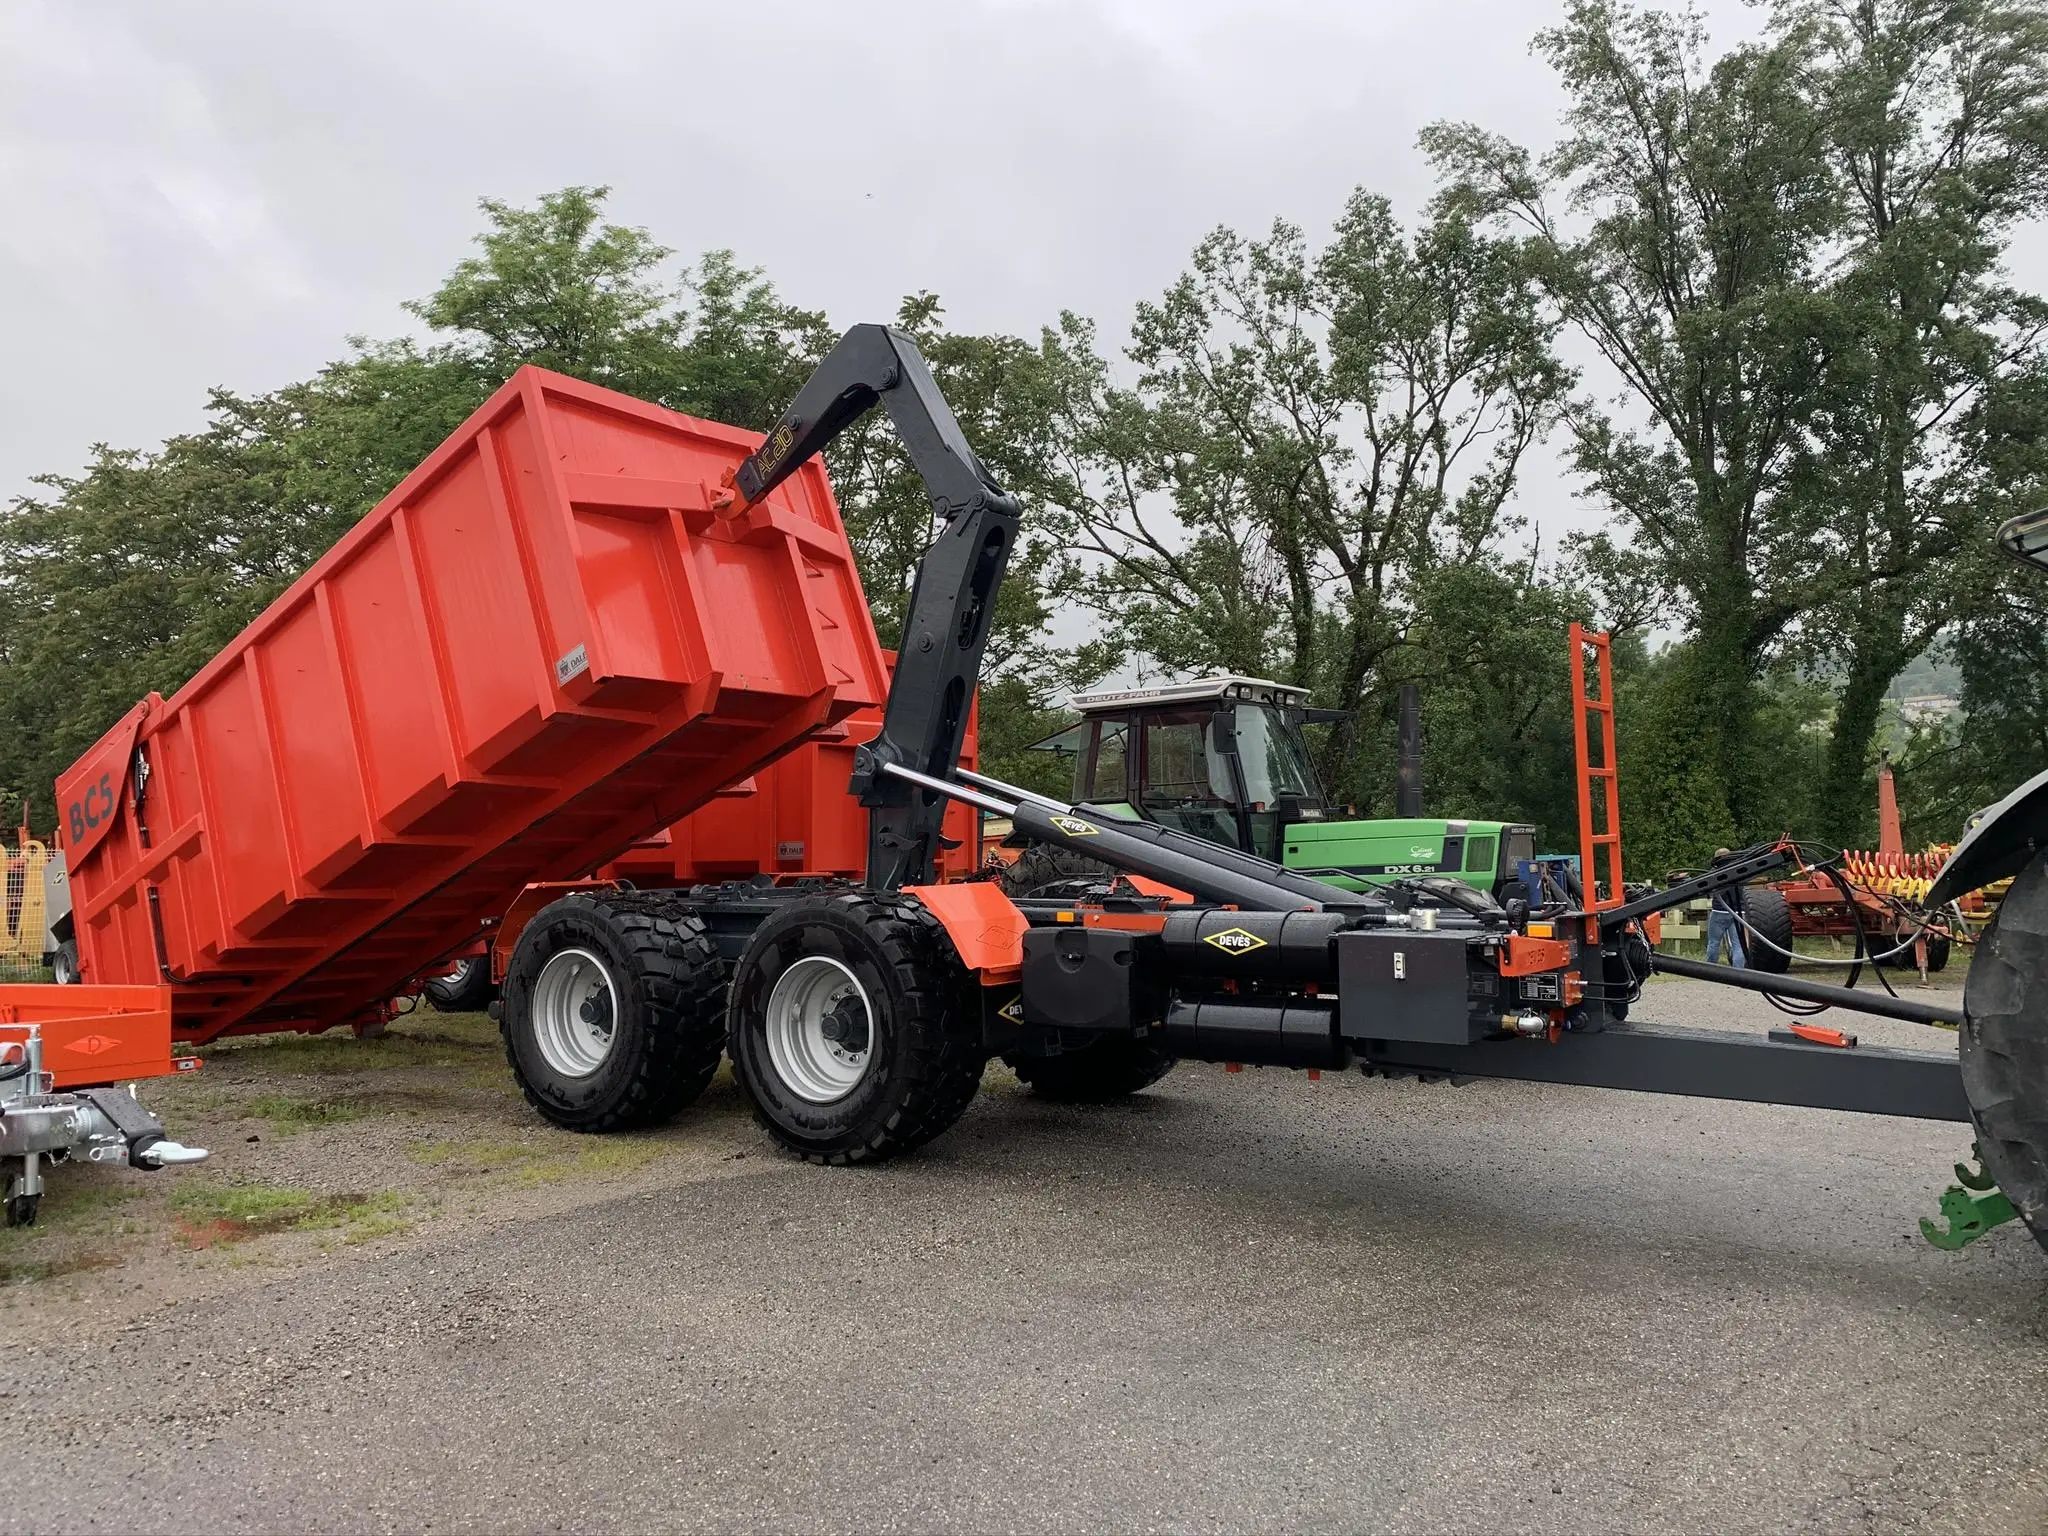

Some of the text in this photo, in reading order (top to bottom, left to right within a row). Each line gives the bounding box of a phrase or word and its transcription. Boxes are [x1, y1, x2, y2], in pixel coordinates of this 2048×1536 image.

[757, 424, 794, 480] AC 210
[69, 772, 114, 845] BC5
[1384, 864, 1435, 874] DX 6.21
